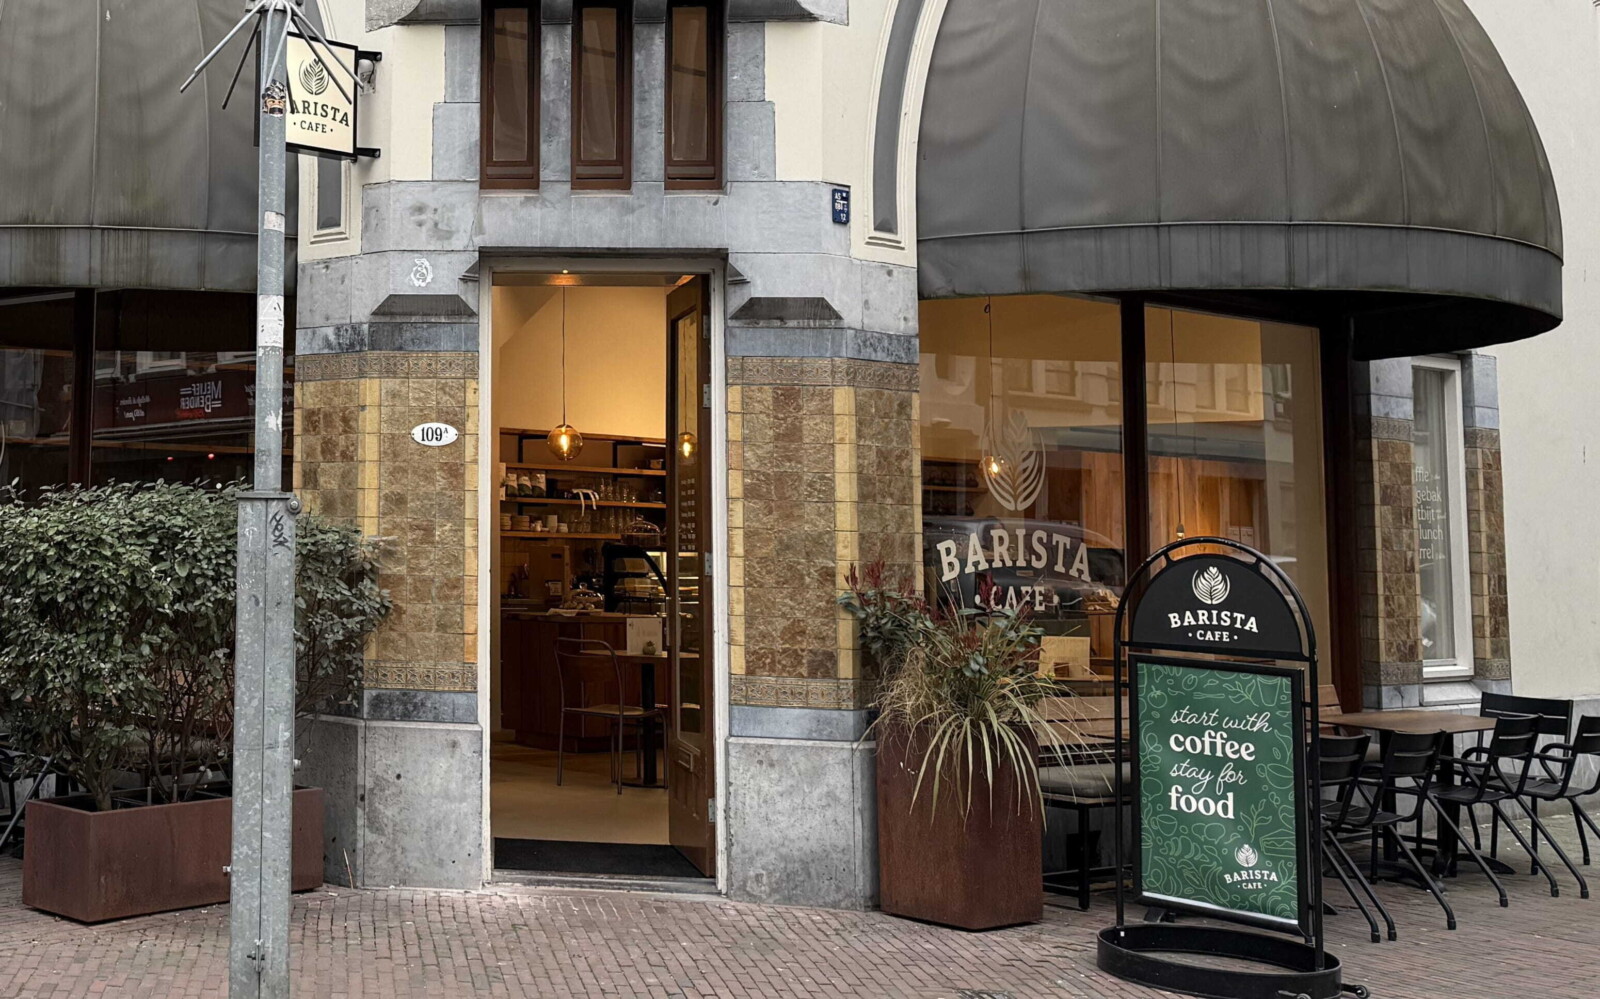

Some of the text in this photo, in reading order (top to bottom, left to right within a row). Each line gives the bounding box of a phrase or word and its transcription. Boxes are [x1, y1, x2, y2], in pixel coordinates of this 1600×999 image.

[288, 99, 350, 127] ARISTA
[300, 120, 327, 134] CAFE
[1417, 505, 1436, 524] tbijt
[1419, 523, 1444, 540] lunch
[936, 528, 1092, 583] BARISTA
[1419, 543, 1434, 560] rrel
[990, 585, 1046, 611] CAFE
[1167, 609, 1259, 633] BARISTA
[1196, 629, 1230, 642] CAFE
[1170, 705, 1272, 732] start with
[1169, 729, 1256, 761] coffee
[1169, 758, 1248, 795] stay for
[1168, 784, 1235, 819] food
[1223, 869, 1279, 884] BARISTA
[1242, 882, 1263, 890] CAFE
